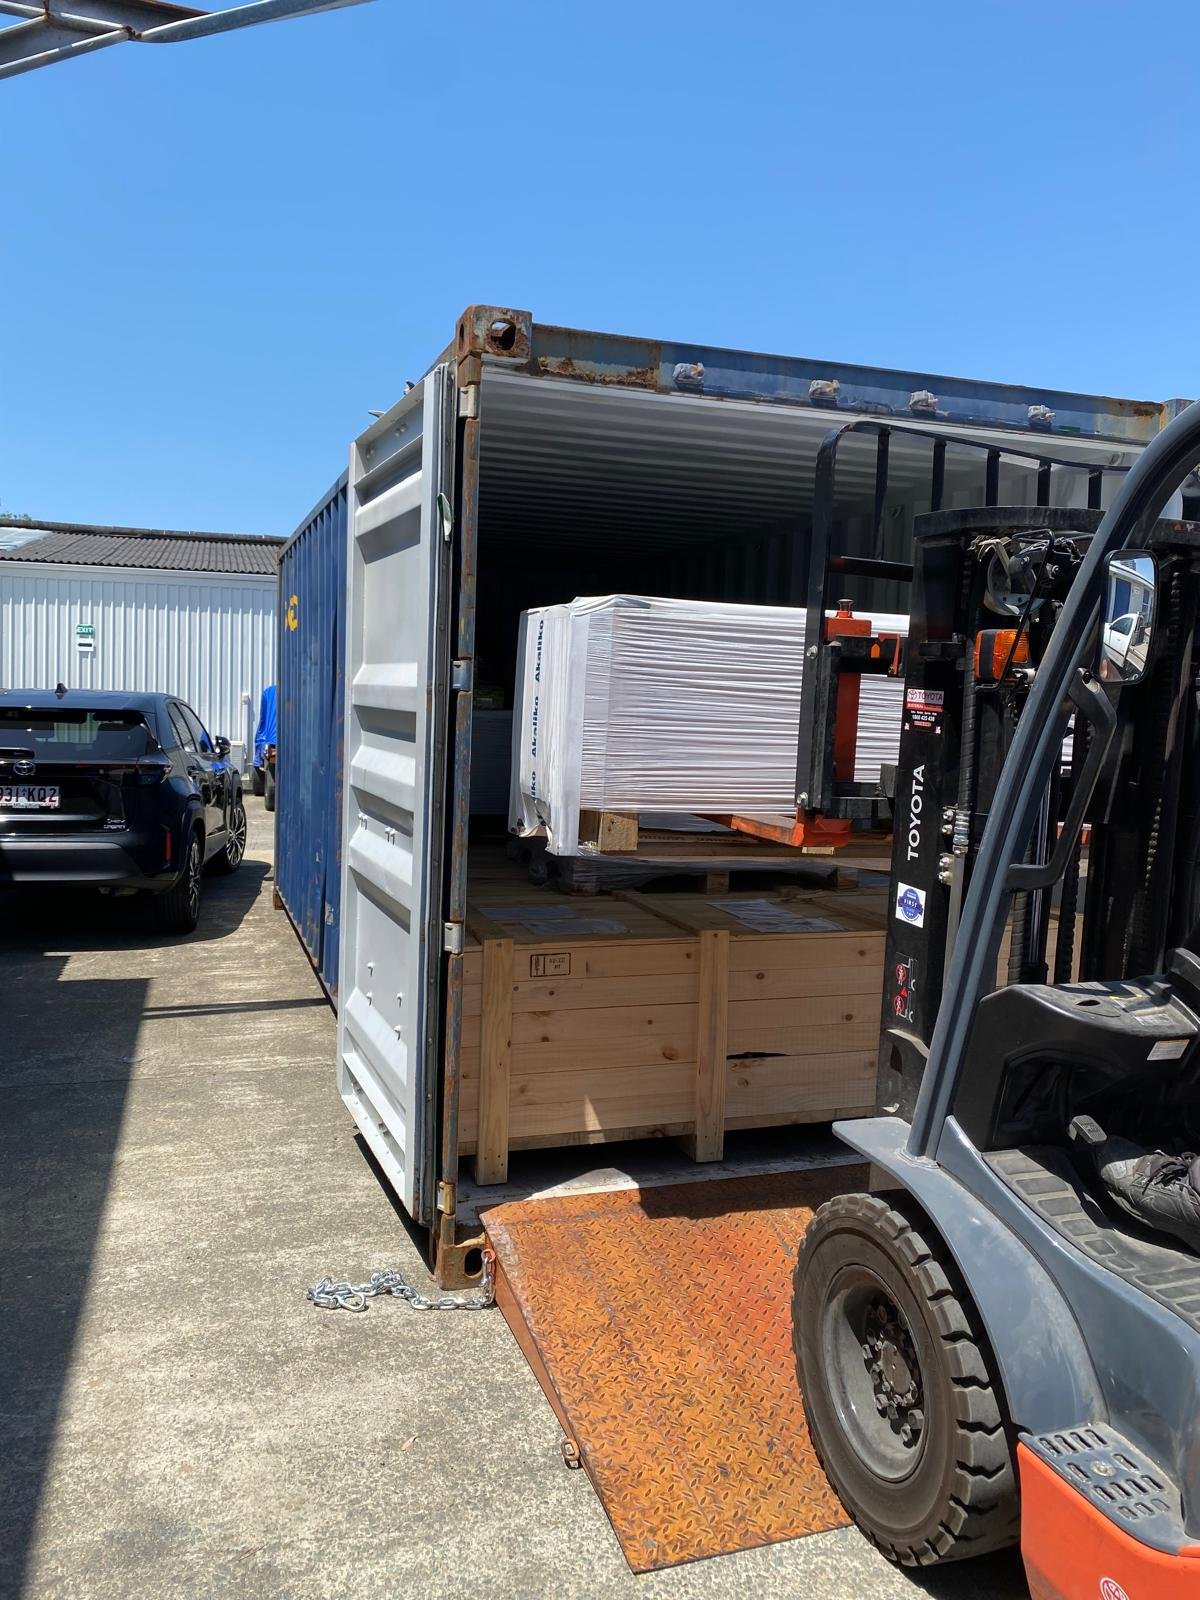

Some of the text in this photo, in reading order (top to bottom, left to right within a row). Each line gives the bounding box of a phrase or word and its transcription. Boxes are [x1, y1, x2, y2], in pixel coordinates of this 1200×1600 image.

[918, 691, 943, 701] TOYOTA
[531, 696, 539, 757] Akaliko
[907, 764, 925, 861] TOYOTA
[903, 898, 918, 908] FIRST
